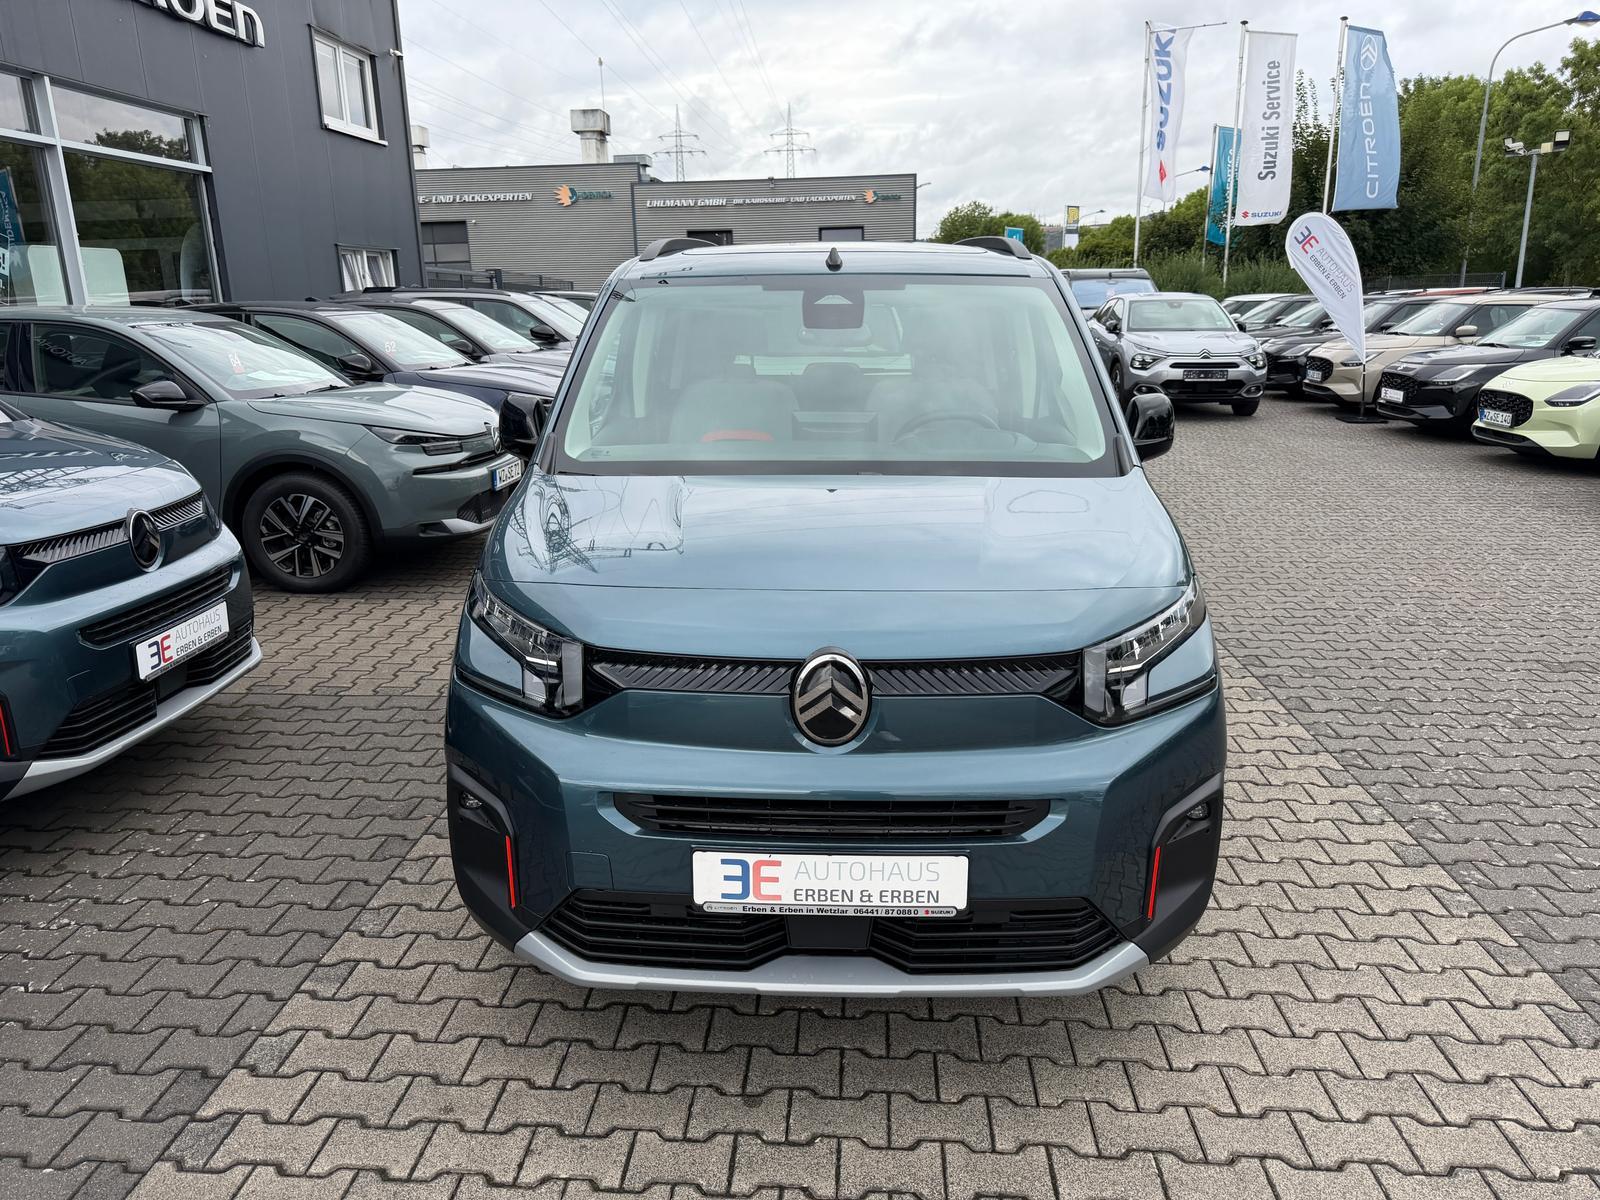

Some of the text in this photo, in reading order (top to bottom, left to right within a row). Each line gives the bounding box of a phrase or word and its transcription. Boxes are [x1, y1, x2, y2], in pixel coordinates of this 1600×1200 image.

[1257, 60, 1281, 181] Suzuki Service
[431, 194, 453, 204] UND
[456, 192, 533, 203] LACKEXPERTEN
[646, 197, 727, 208] UHLMANN GMBH
[1250, 210, 1282, 219] SUZUKI
[1309, 254, 1328, 276] ERBEN
[1328, 279, 1347, 300] ERBEN
[1316, 247, 1356, 293] AUTOHAUS
[174, 608, 221, 643] AUTOHAUS
[176, 639, 197, 657] ERBEN
[197, 636, 204, 646] &
[203, 624, 222, 642] ERBEN
[794, 860, 940, 882] AUTOHAUS
[793, 888, 940, 904] ERBEN & ERBEN
[742, 905, 767, 913] Erben
[779, 906, 804, 914] Erben
[806, 906, 815, 914] in
[816, 906, 849, 915] Wetzlar
